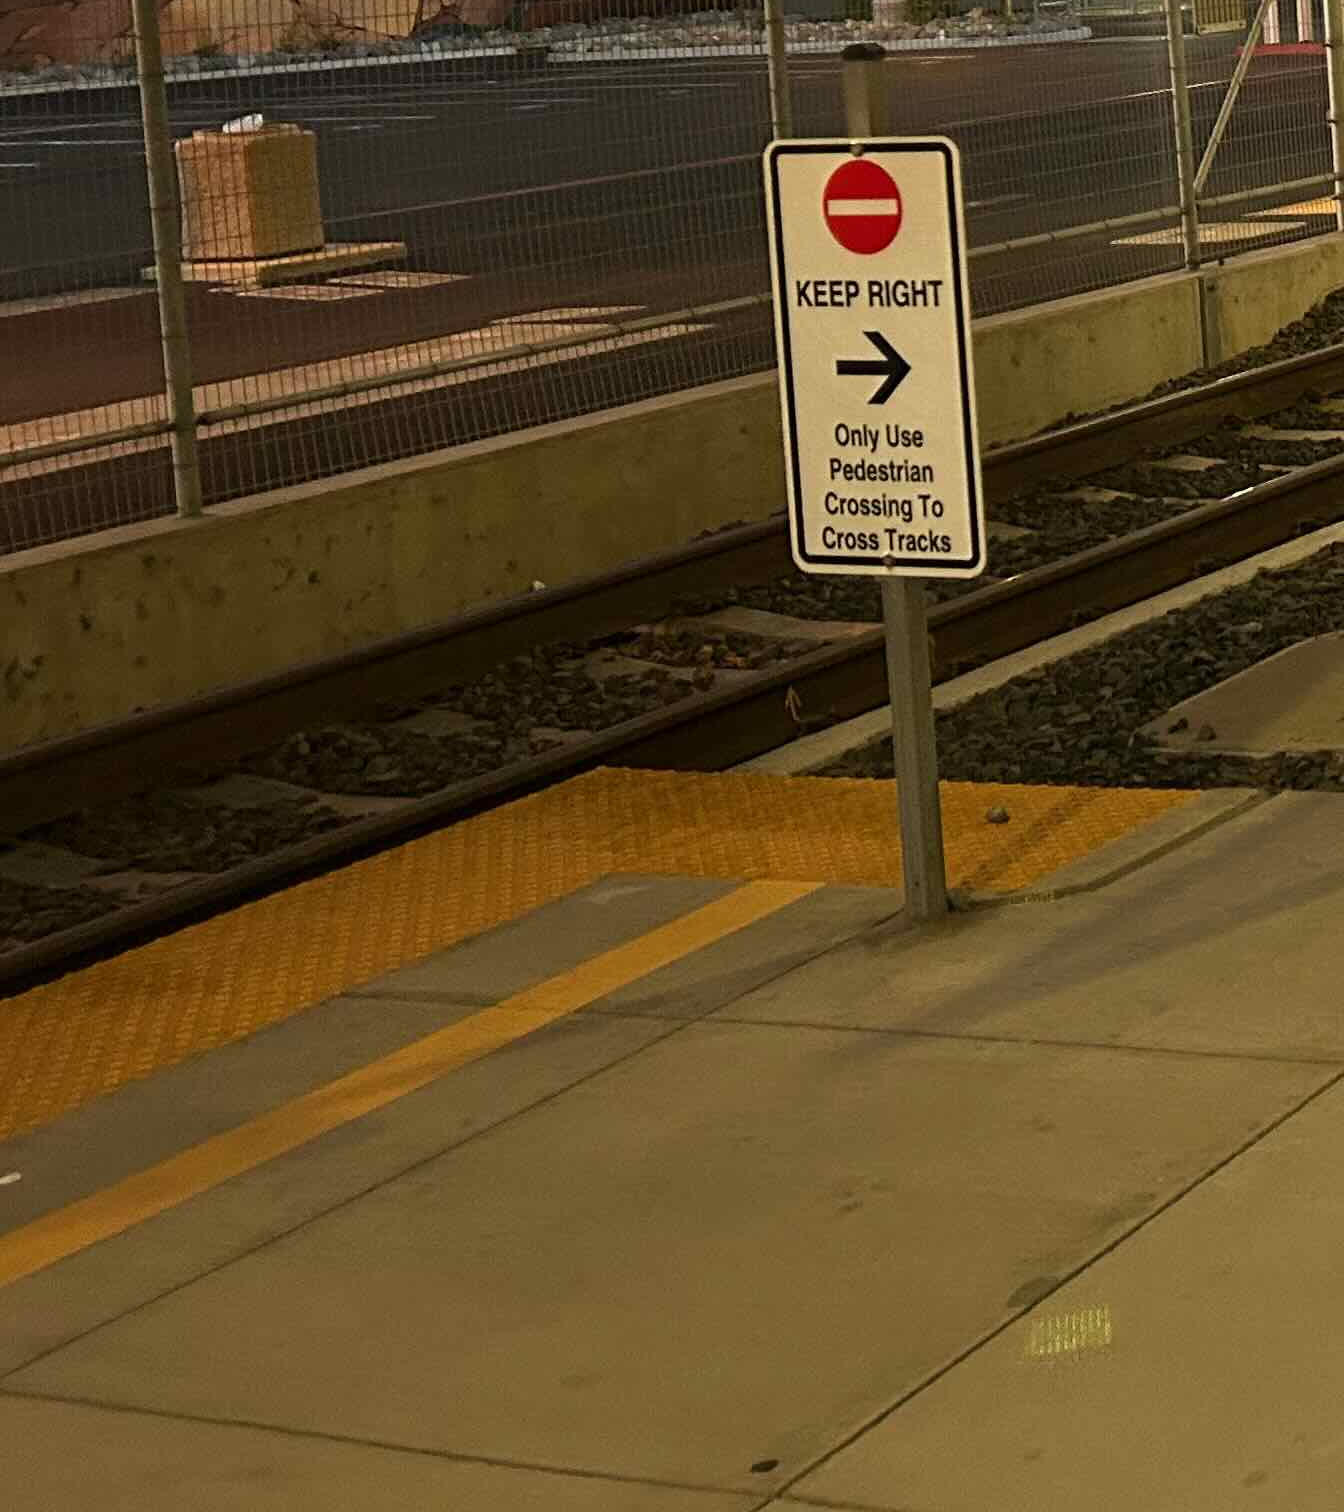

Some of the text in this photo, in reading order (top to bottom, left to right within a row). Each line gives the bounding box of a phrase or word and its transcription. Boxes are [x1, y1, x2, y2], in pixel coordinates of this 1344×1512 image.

[796, 279, 943, 307] KEEP RIGHT
[834, 423, 923, 453] Only Use
[829, 457, 934, 483] Pedestrian
[824, 491, 944, 523] Crossing To
[821, 525, 952, 553] Cross Tracks
